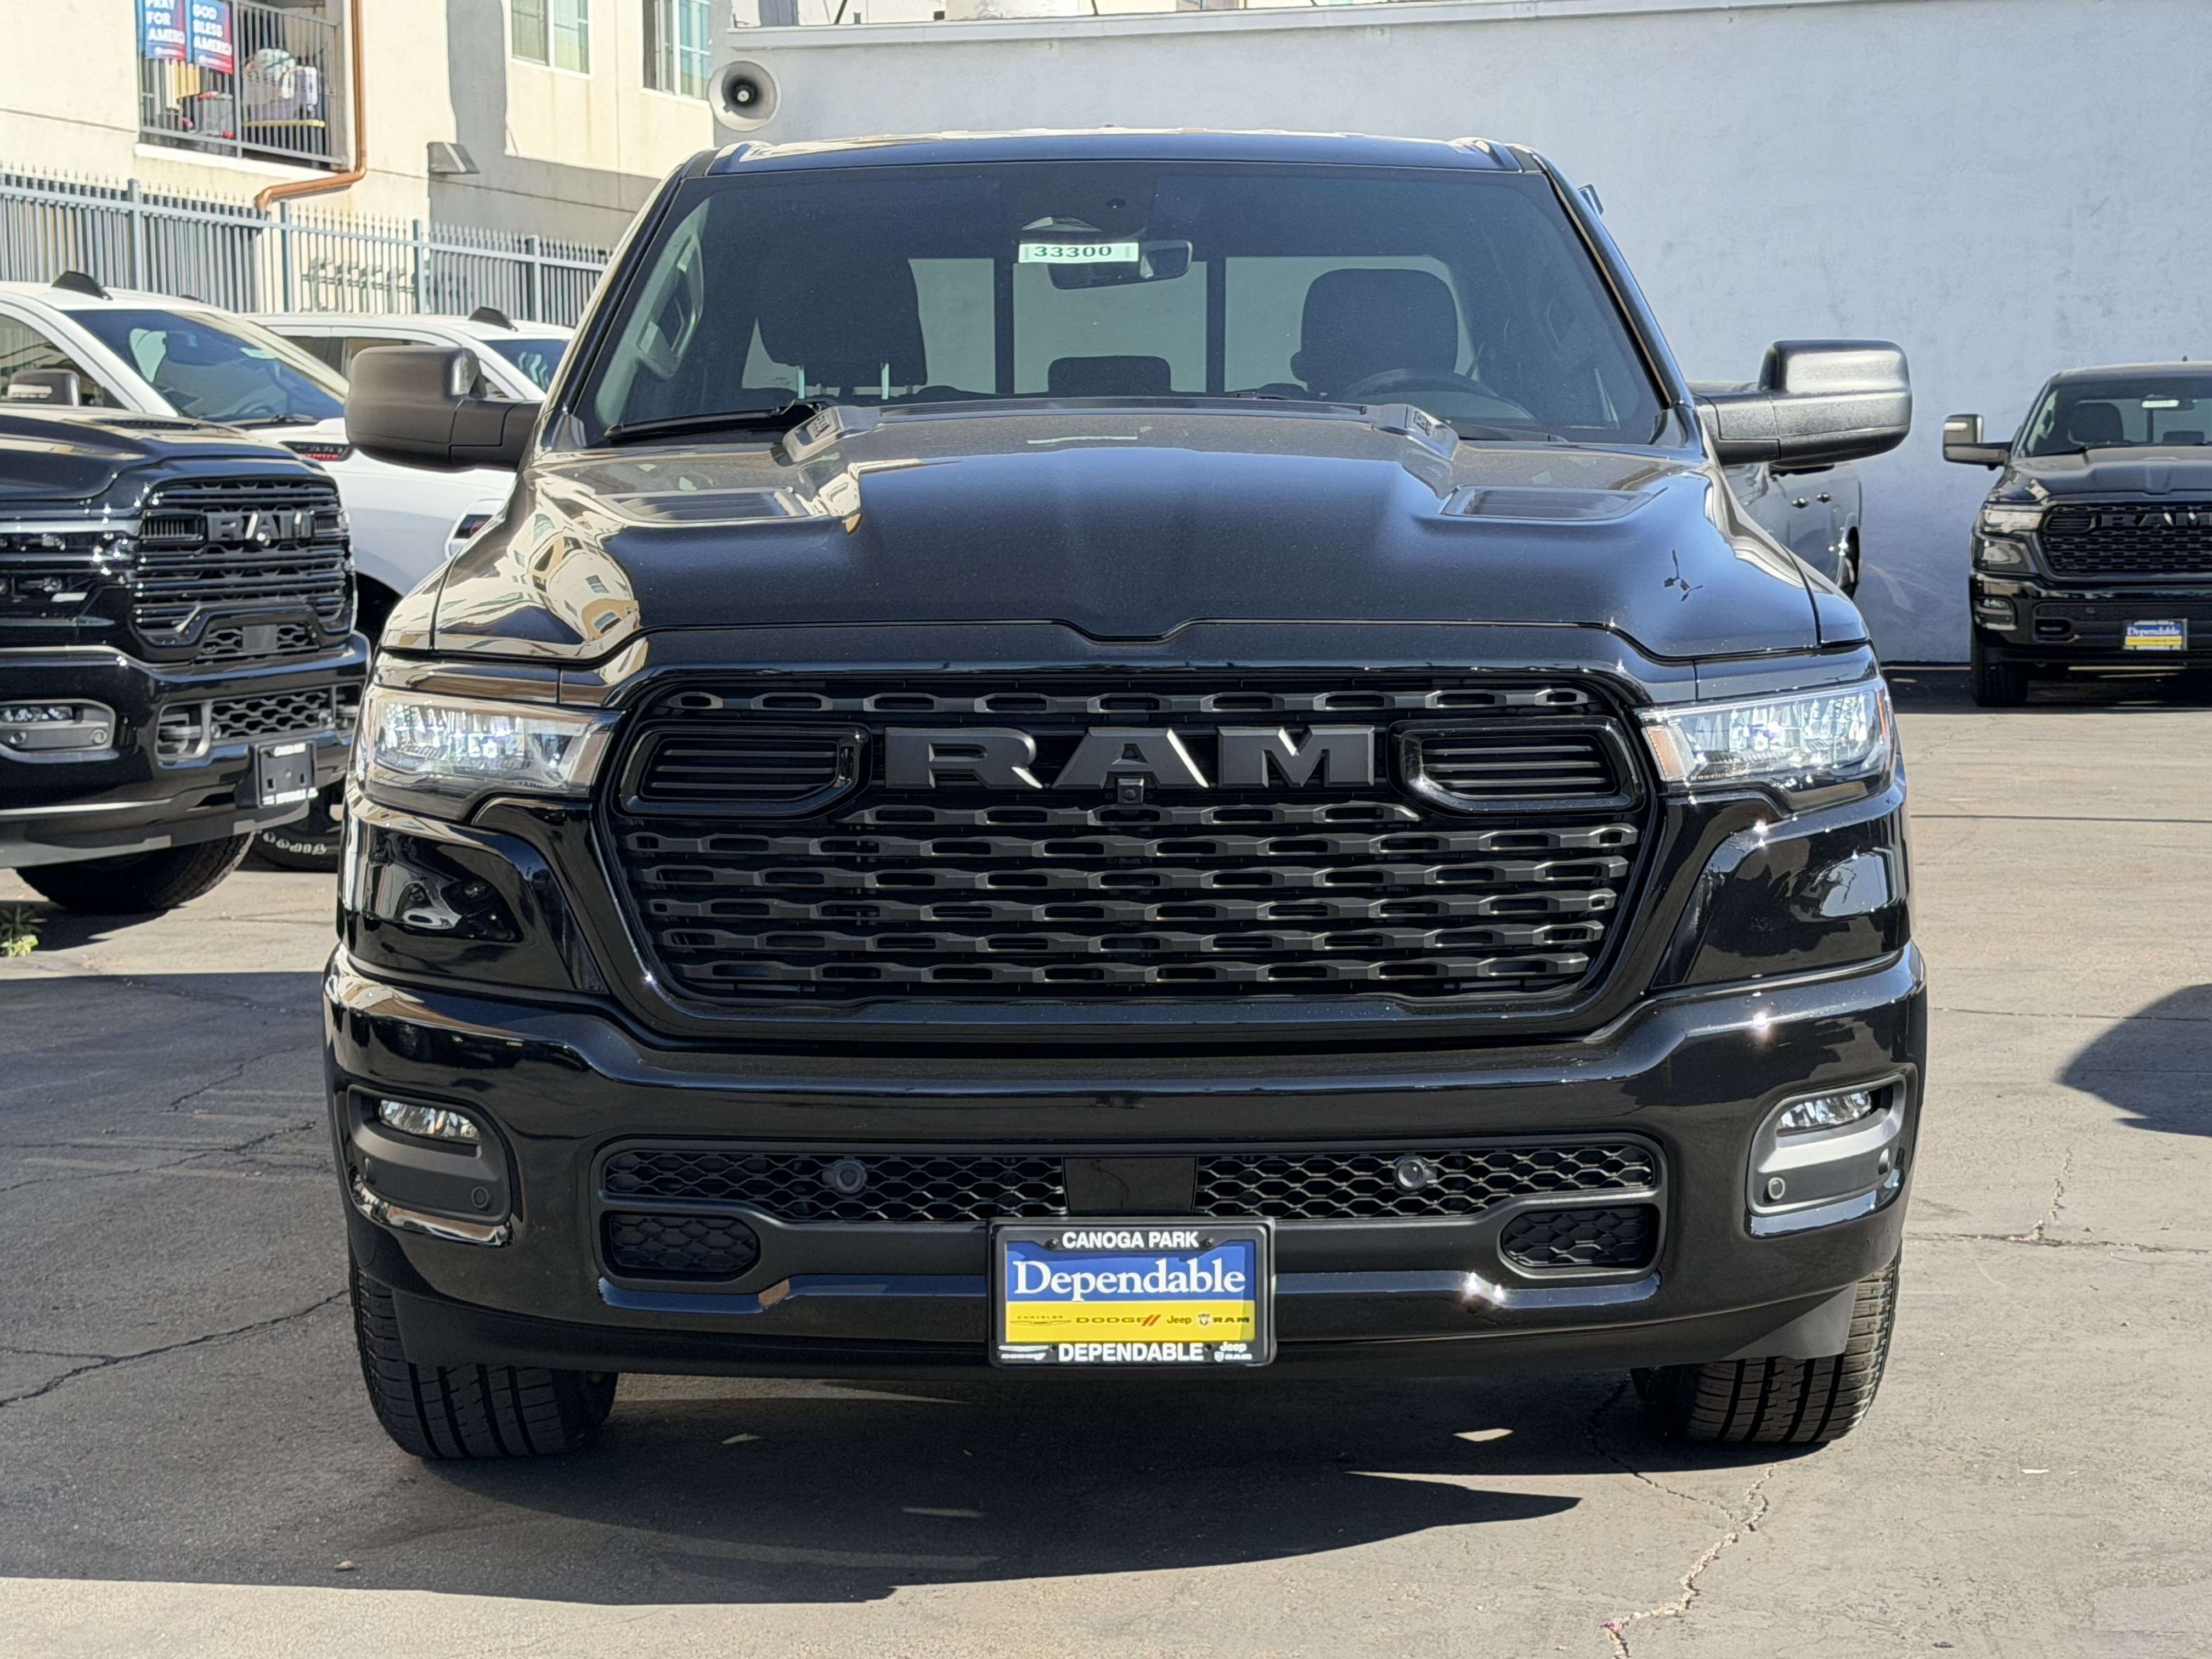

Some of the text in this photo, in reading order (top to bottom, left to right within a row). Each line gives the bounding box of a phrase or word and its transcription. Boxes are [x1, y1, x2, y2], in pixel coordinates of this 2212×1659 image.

[146, 11, 171, 25] FOR
[193, 3, 217, 20] GOD
[193, 19, 223, 37] BLESS
[1034, 246, 1112, 257] 33300
[207, 511, 312, 541] RAM
[2100, 512, 2212, 527] RAM
[885, 726, 1375, 788] RAM
[1062, 1231, 1199, 1249] CANOGA PARK
[1012, 1258, 1246, 1302] Dependable
[1166, 1314, 1192, 1325] Jeep
[1059, 1343, 1204, 1361] DEPENDABLE
[1220, 1341, 1247, 1353] Jeep
